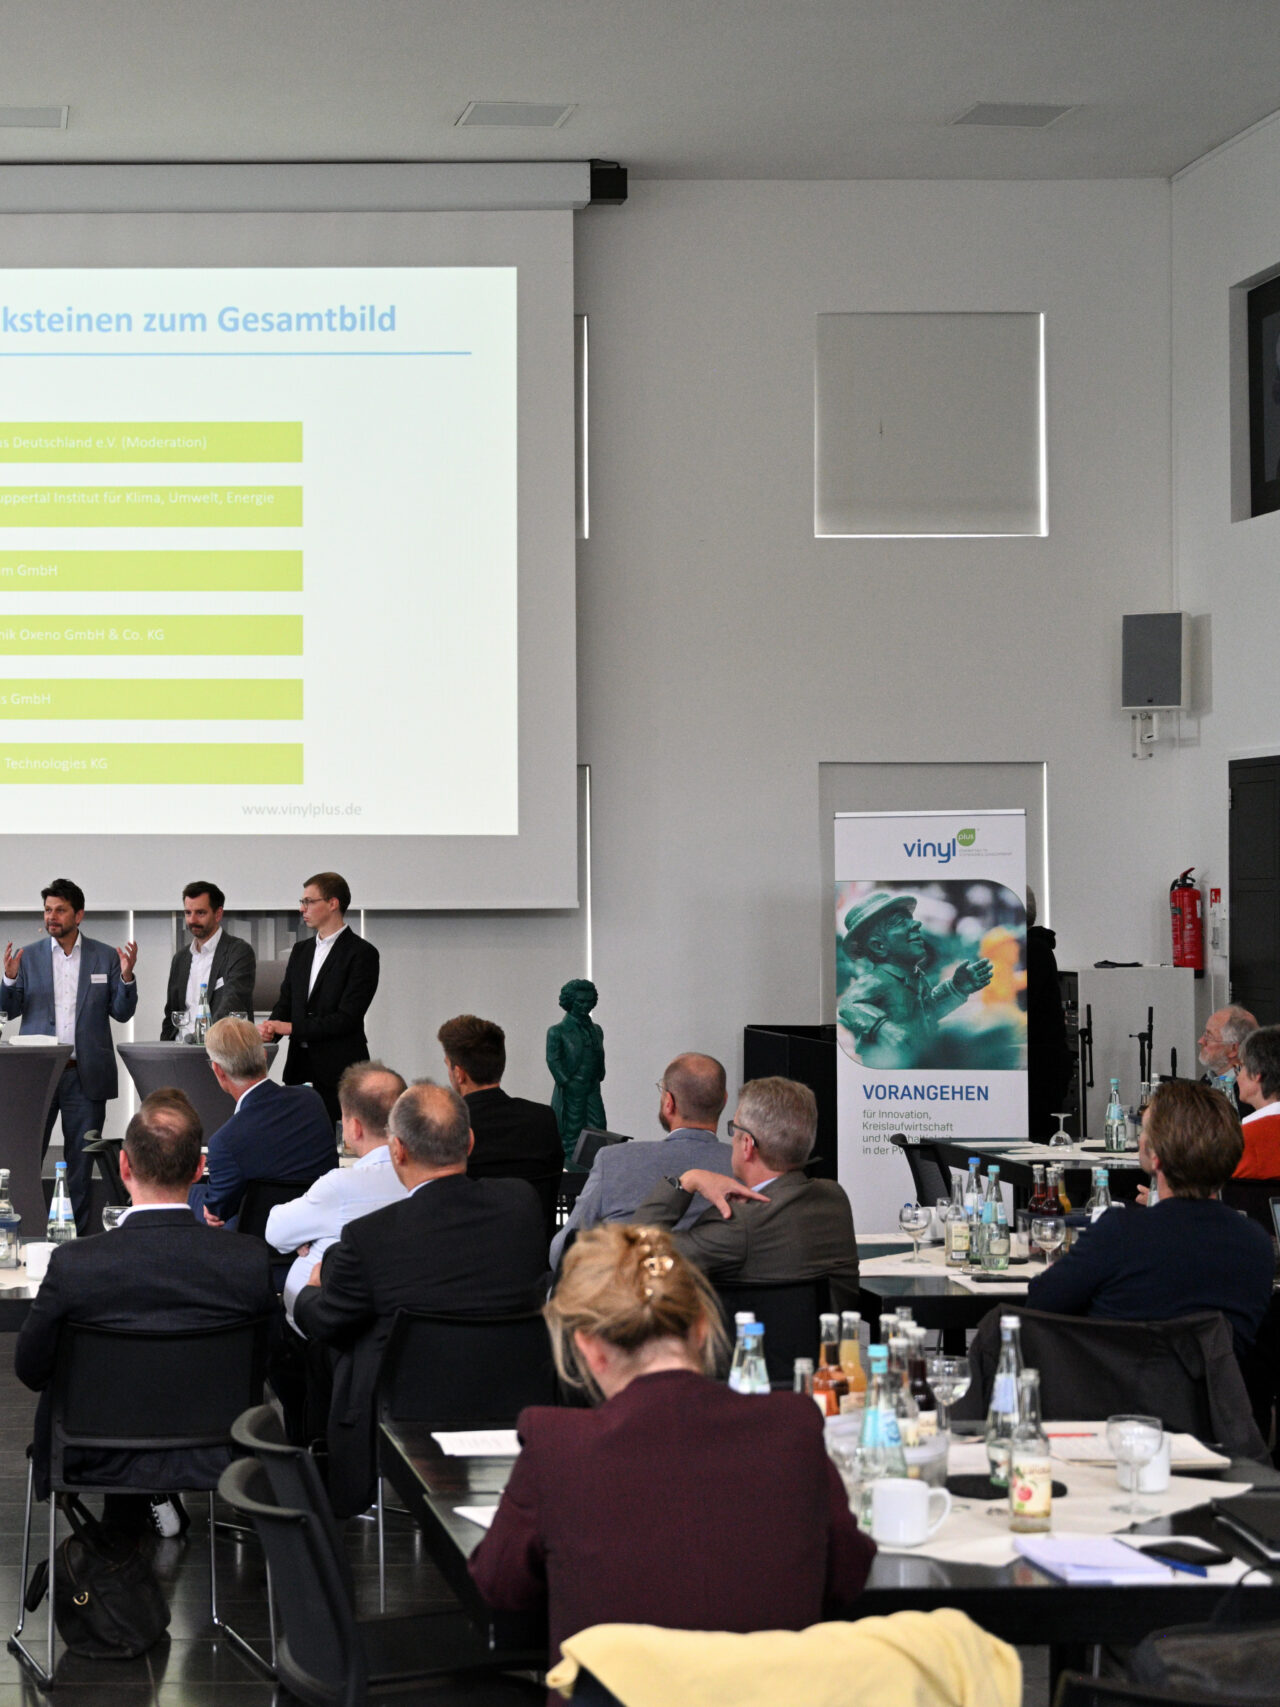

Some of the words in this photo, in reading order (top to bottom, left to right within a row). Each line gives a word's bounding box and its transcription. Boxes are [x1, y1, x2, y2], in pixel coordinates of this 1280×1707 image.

[143, 312, 208, 333] zum
[216, 304, 397, 333] Gesamtbild
[13, 435, 92, 449] Deutschland
[95, 436, 118, 449] e.V.
[121, 434, 207, 451] (Moderation)
[53, 491, 99, 504] Institut
[103, 491, 122, 504] für
[125, 491, 165, 506] Klima,
[168, 491, 223, 506] Umwelt,
[226, 491, 275, 507] Energie
[16, 563, 58, 577] GmbH
[19, 628, 61, 641] Oxeno
[63, 627, 105, 641] GmbH
[108, 627, 119, 641] &
[122, 628, 144, 641] Co.
[147, 628, 165, 641] KG
[10, 692, 52, 705] GmbH
[4, 756, 88, 773] Technologies
[90, 757, 108, 770] KG
[241, 801, 363, 819] www.vinylplus.de
[903, 837, 957, 864] vinyl
[958, 832, 974, 841] plus
[862, 1084, 989, 1101] VORANGEHEN
[862, 1109, 877, 1119] für
[878, 1109, 932, 1120] Innovation,
[862, 1121, 954, 1132] Kreislaufwirtschaft
[862, 1133, 881, 1143] und
[862, 1146, 872, 1155] in
[873, 1146, 889, 1155] der
